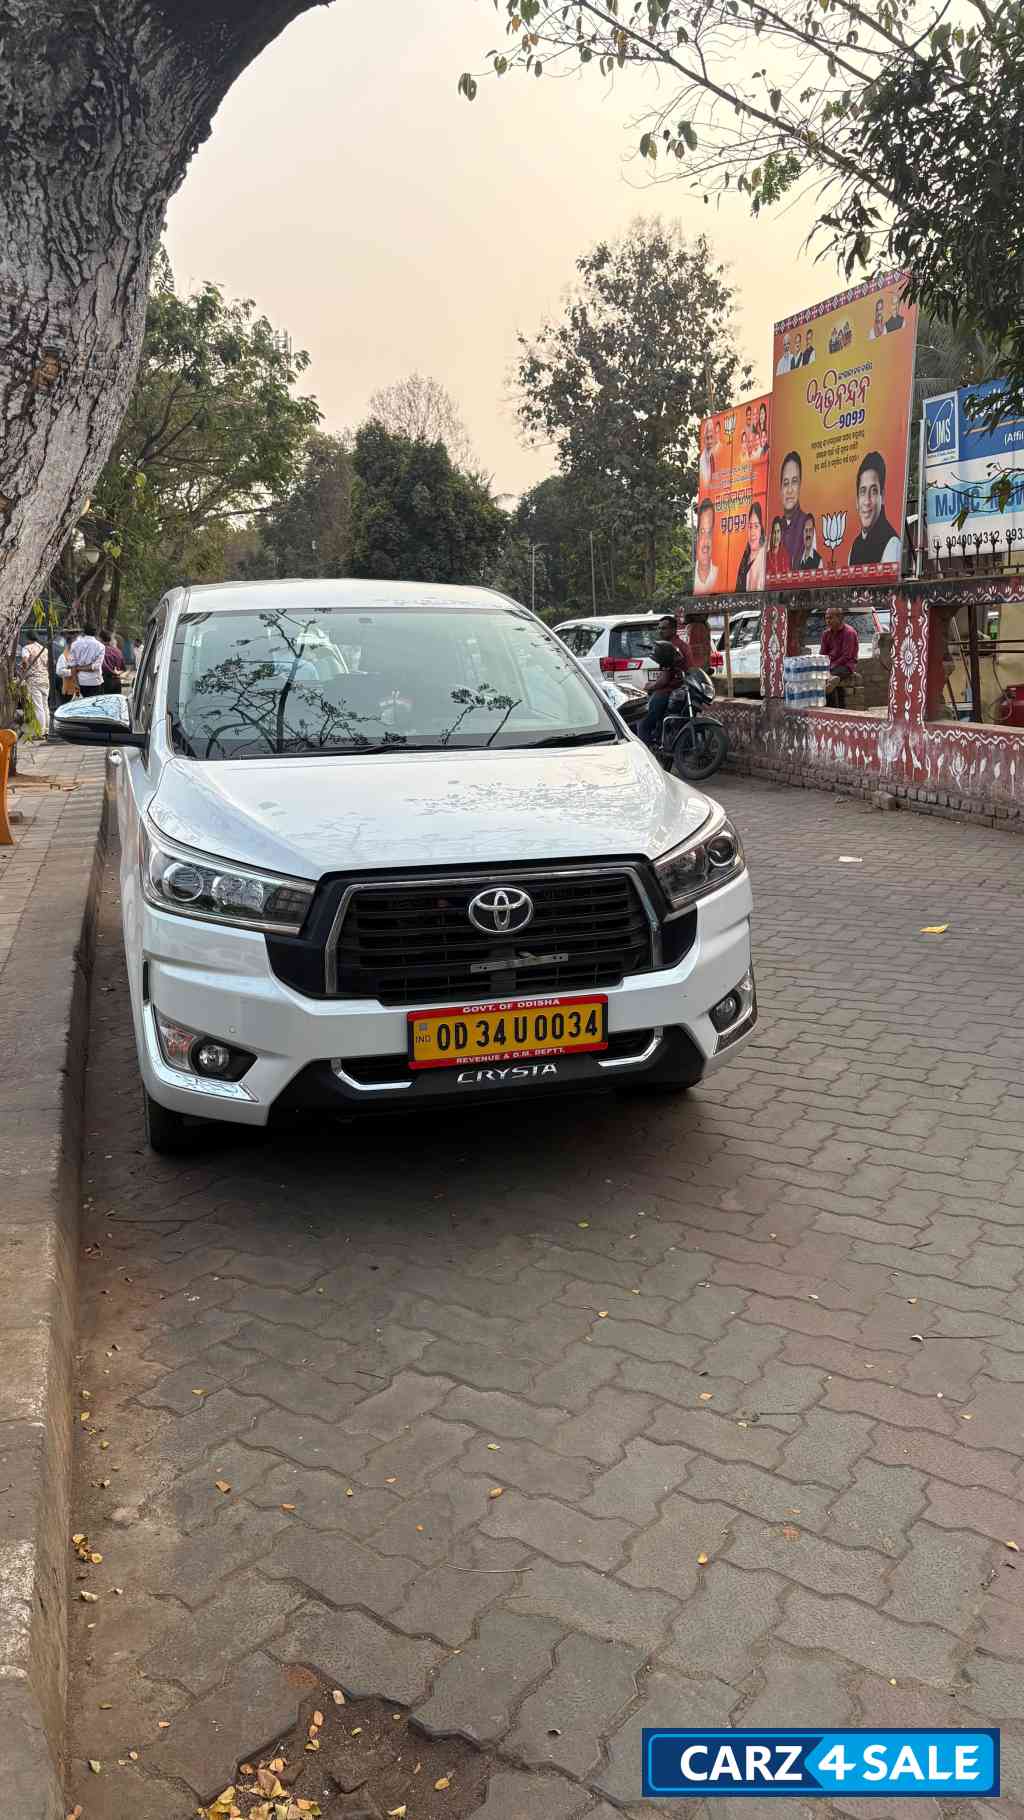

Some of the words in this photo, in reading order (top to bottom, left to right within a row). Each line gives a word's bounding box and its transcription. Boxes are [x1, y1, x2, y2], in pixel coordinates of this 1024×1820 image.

[462, 1004, 496, 1014] GOVT.
[517, 999, 561, 1009] ODISHA
[475, 1018, 506, 1048] 34
[456, 1054, 500, 1064] REVENUE
[456, 1063, 559, 1084] CRYSTA
